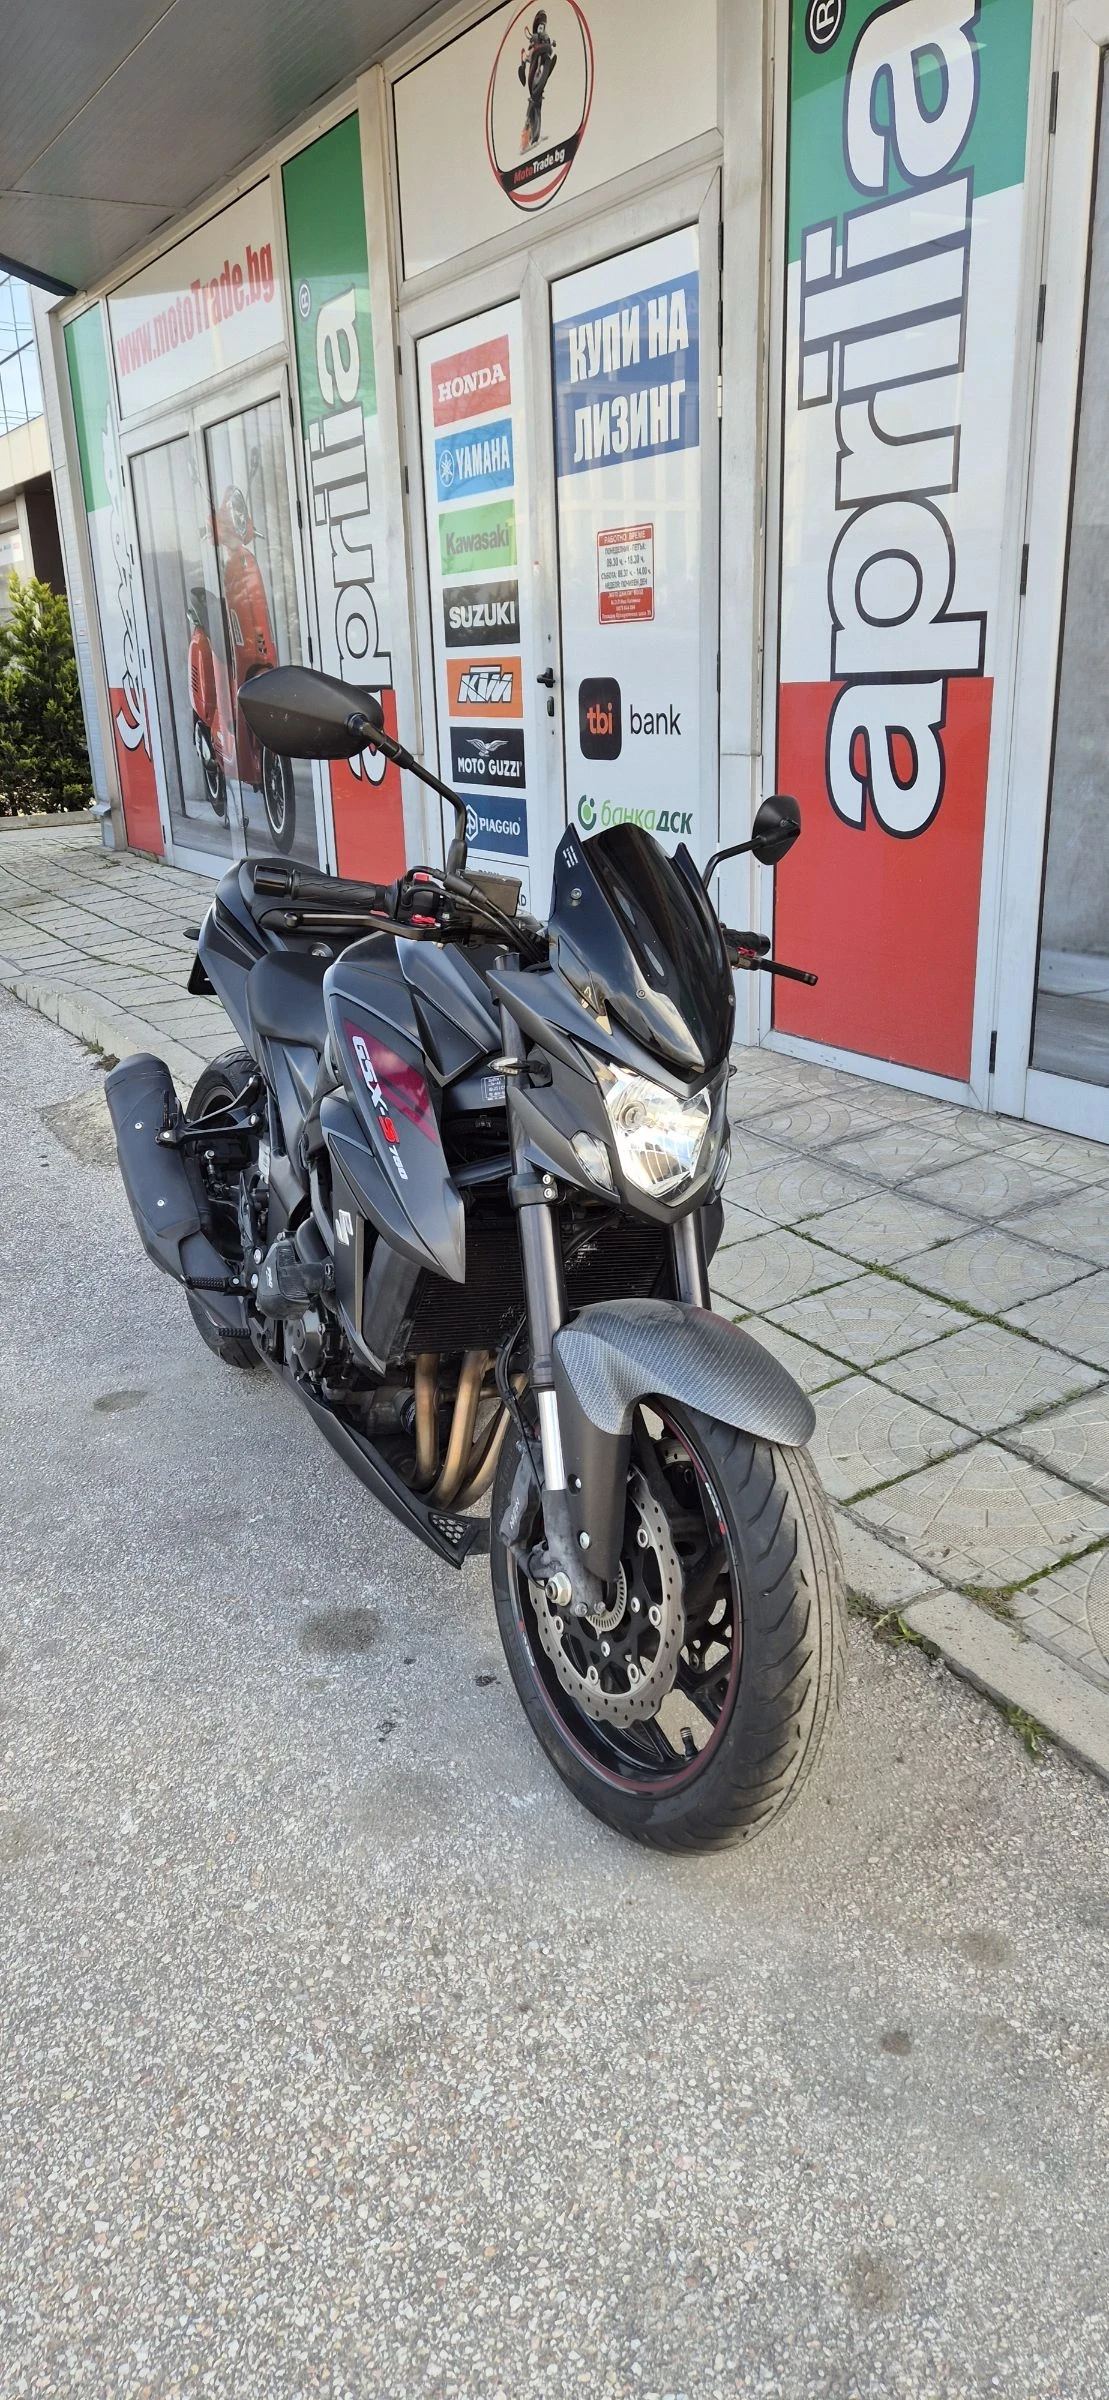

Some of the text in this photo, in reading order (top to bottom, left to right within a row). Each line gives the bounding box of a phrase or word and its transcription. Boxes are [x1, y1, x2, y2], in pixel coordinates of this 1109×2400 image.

[514, 149, 566, 183] MotoTrade.bg
[117, 243, 275, 376] www.motoTrade.bg
[568, 289, 689, 384] КУПИ НА
[438, 363, 506, 402] HONDA
[573, 380, 686, 463] ЛИЗИНГ
[798, 0, 988, 840] aprilia
[455, 436, 511, 480] YAMAHA
[446, 523, 510, 556] Kawasaki
[449, 601, 516, 629] SUZUKI
[457, 664, 513, 703] KTM
[587, 703, 681, 735] tbi bank
[458, 757, 485, 774] MOTO
[479, 817, 520, 836] PIAGGIO
[352, 1035, 400, 1144] GSX-S
